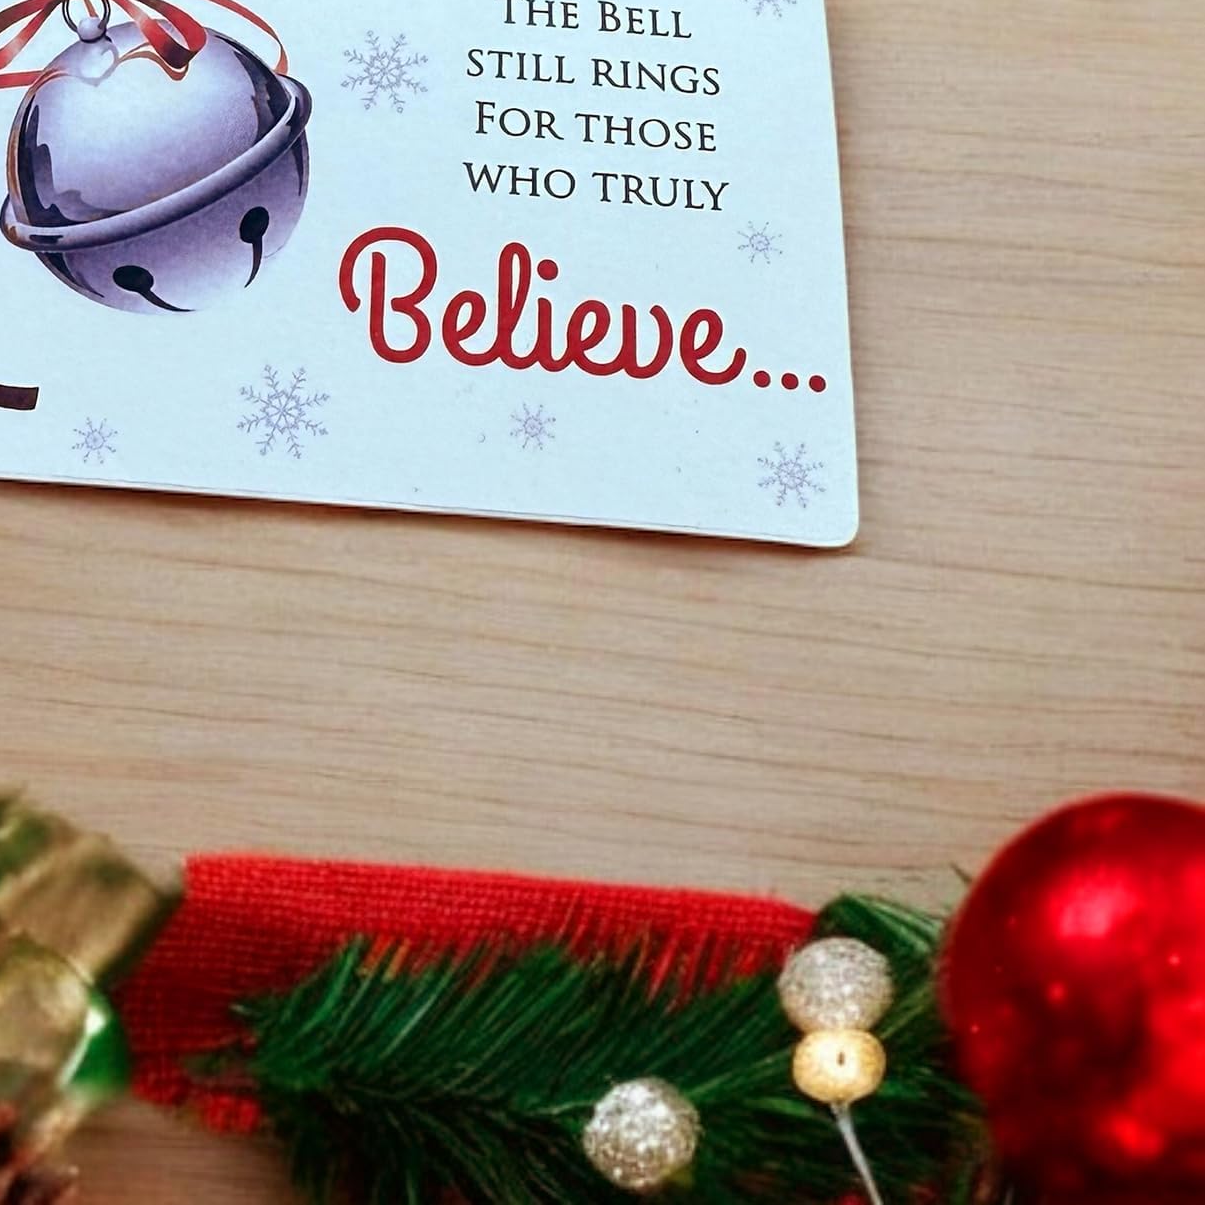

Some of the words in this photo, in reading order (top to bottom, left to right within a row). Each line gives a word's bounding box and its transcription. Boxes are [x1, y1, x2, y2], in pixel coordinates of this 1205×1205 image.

[466, 48, 576, 85] STILL
[591, 57, 721, 96] RINGS
[475, 100, 565, 141] FOR
[574, 111, 718, 152] THOSE
[462, 160, 576, 199] WHO
[592, 171, 731, 211] TRULY
[339, 226, 827, 392] Believe...
